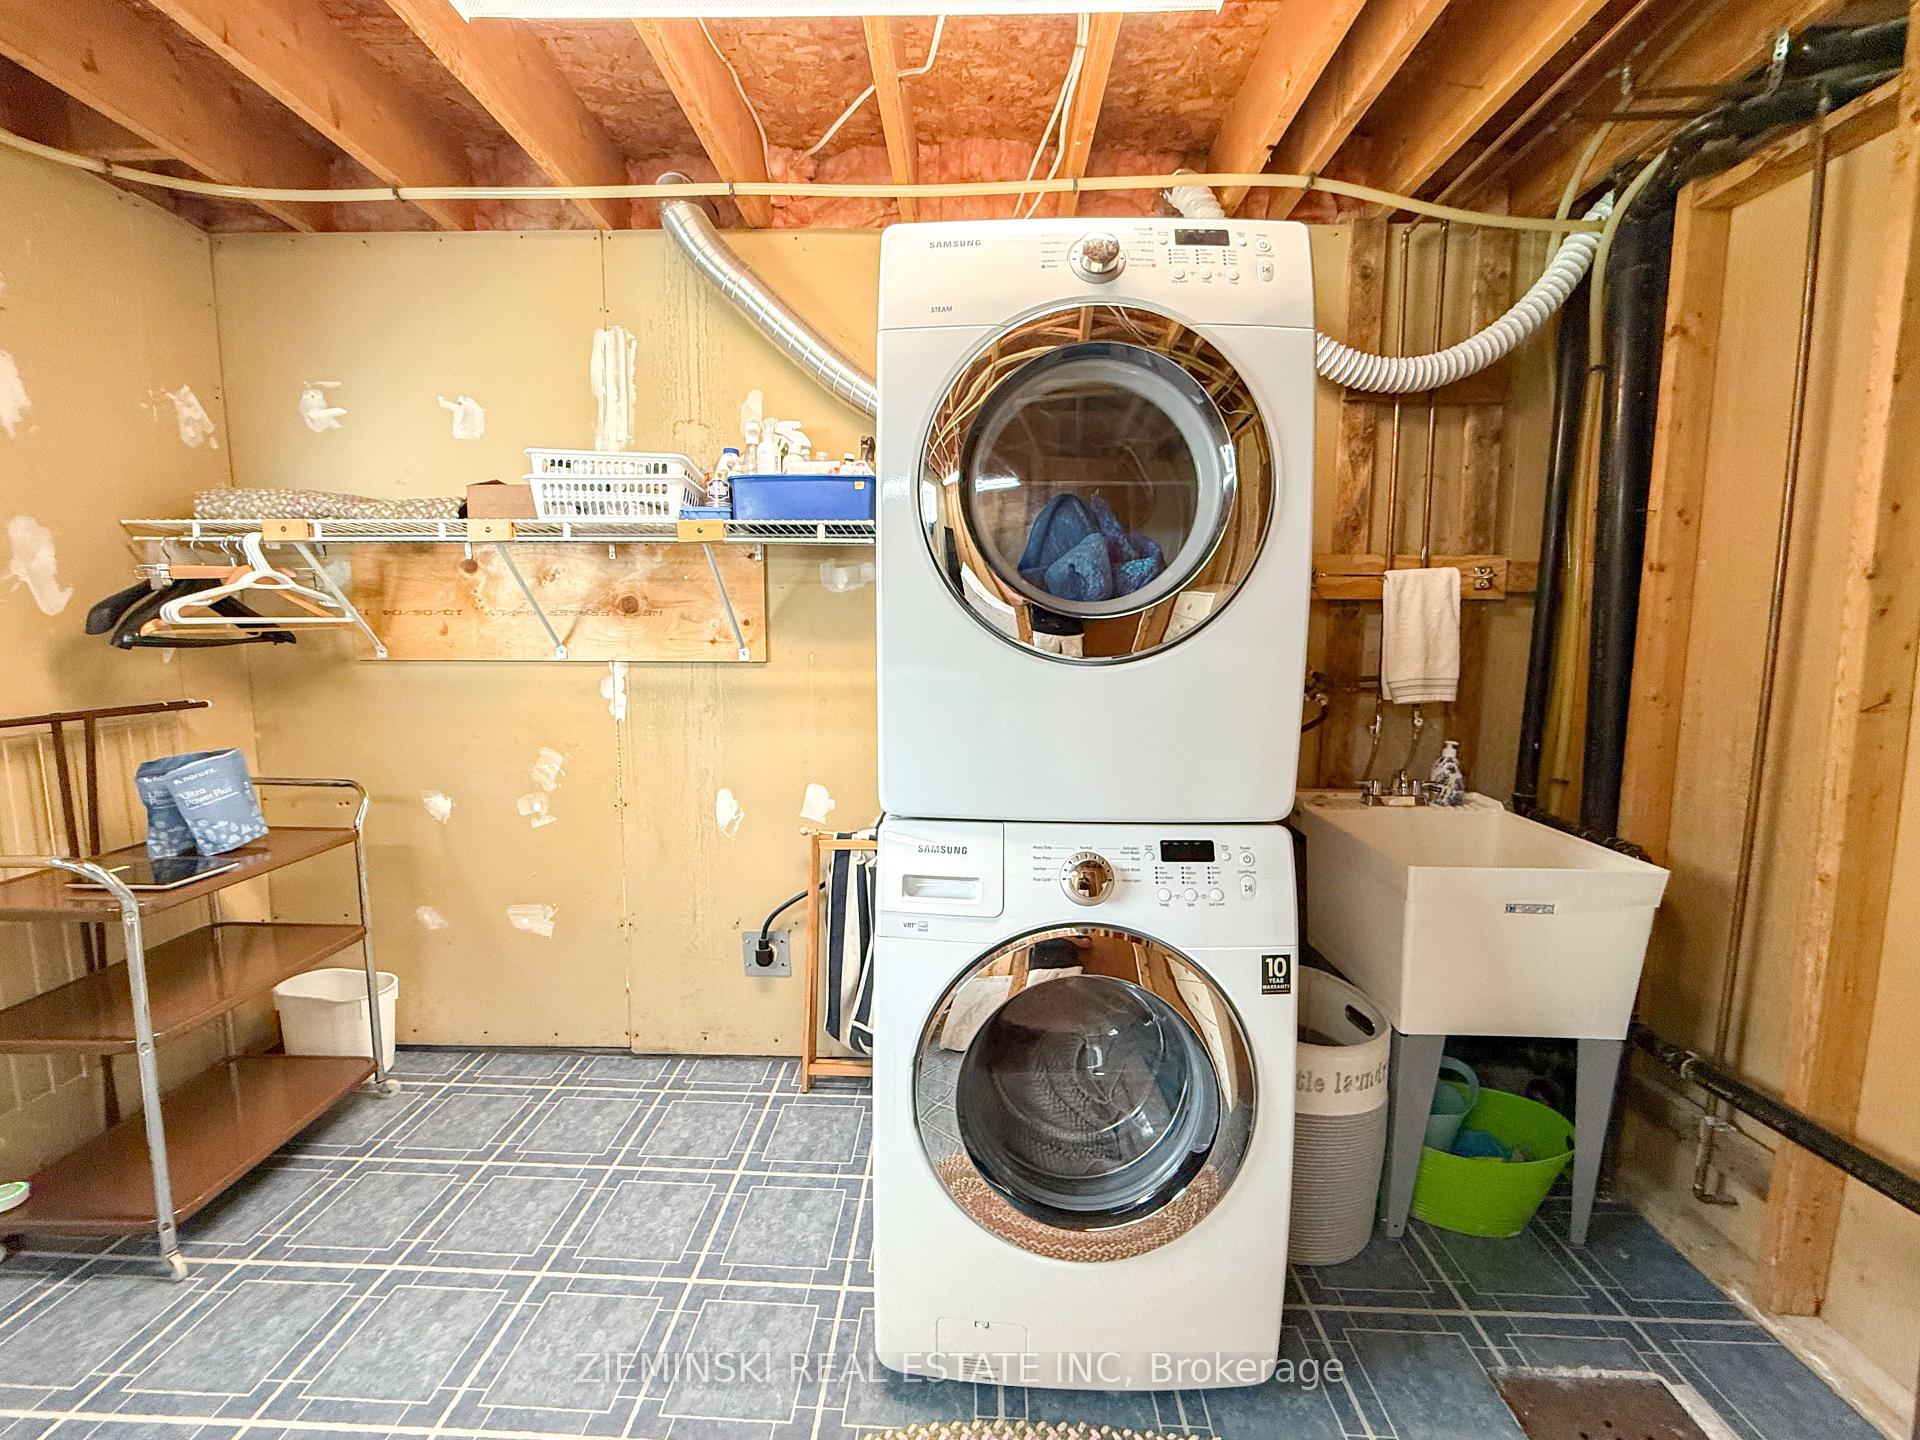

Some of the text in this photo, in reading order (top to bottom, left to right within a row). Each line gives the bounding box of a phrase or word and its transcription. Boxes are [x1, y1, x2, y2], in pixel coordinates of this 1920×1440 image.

[929, 240, 981, 248] SAMSUNG
[180, 788, 206, 800] Ultra
[184, 794, 213, 807] Power
[918, 845, 968, 855] SAMSUNG
[1265, 957, 1287, 977] 10
